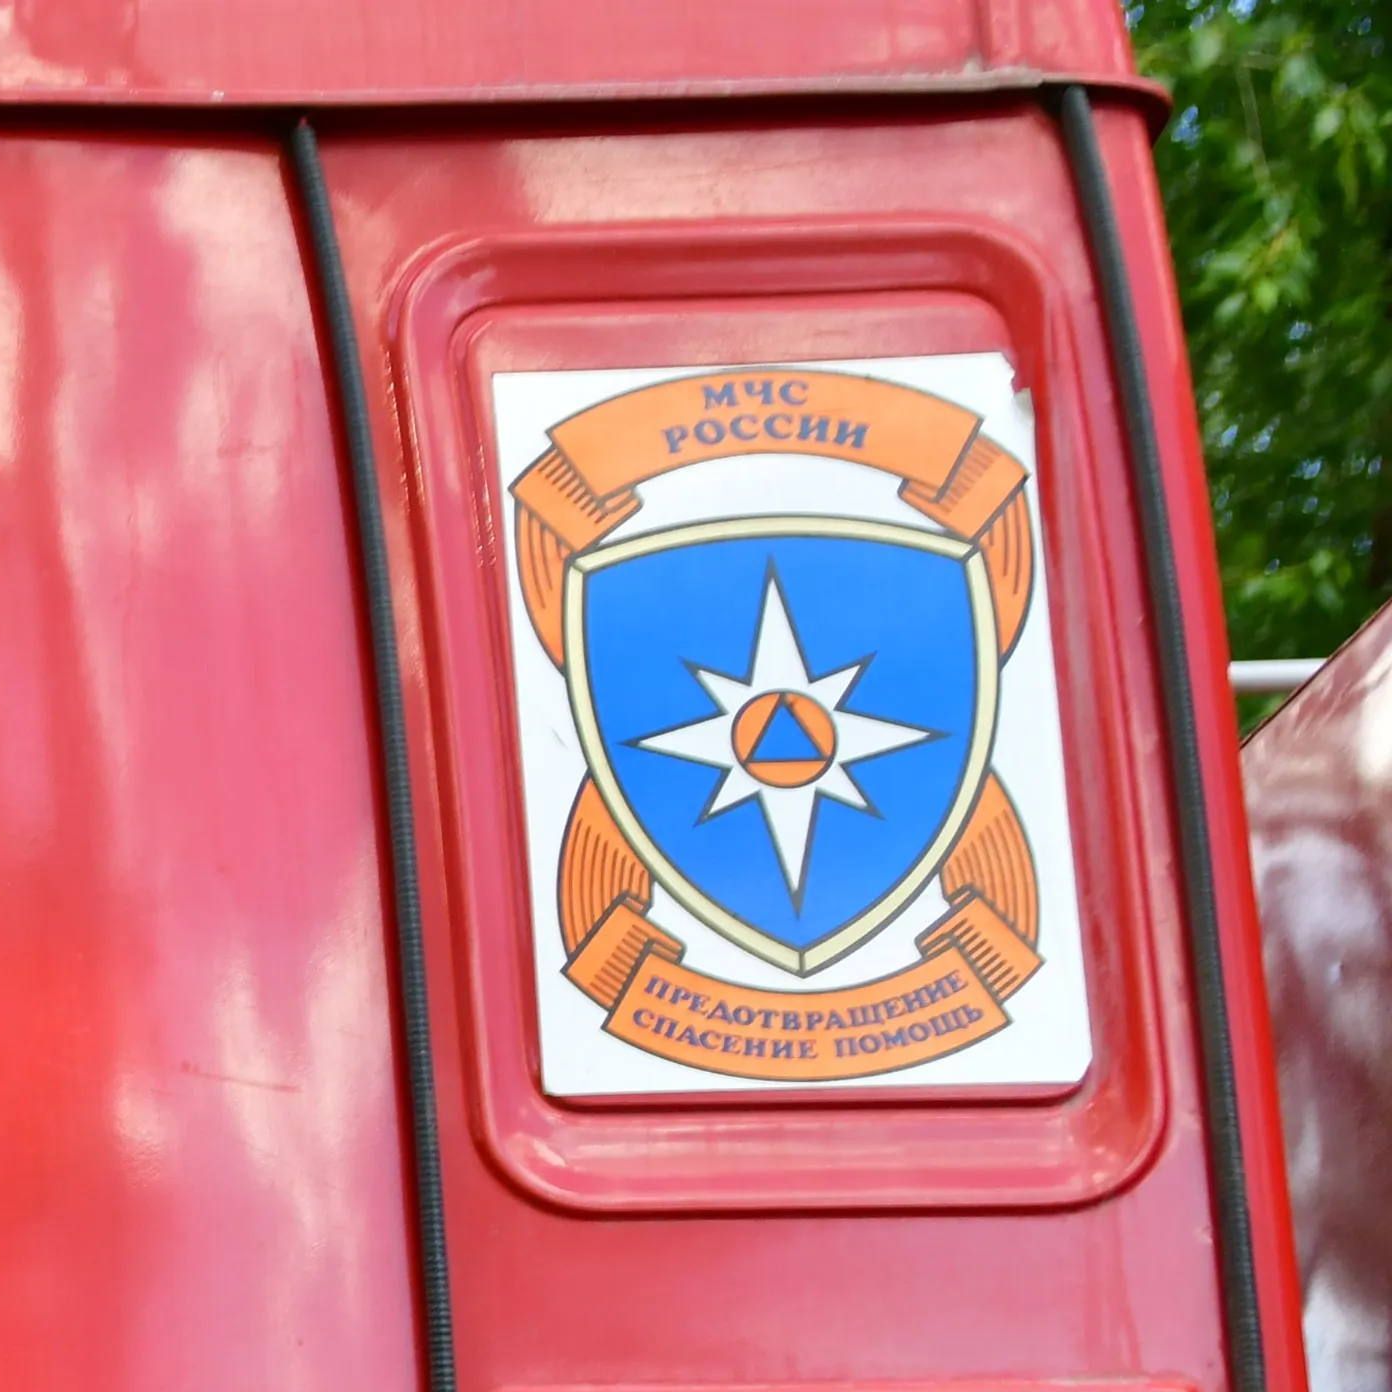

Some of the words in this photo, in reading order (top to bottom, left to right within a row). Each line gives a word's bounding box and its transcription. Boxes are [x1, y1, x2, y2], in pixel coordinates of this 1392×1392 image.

[701, 379, 811, 409] МЧС
[661, 413, 869, 454] РОССИИ
[642, 969, 969, 1032] ПРЕДОТВРАЩЕНИЕ
[631, 1007, 819, 1060] СПАСЕНИЕ
[835, 1001, 984, 1059] ПОМОЩЬ
